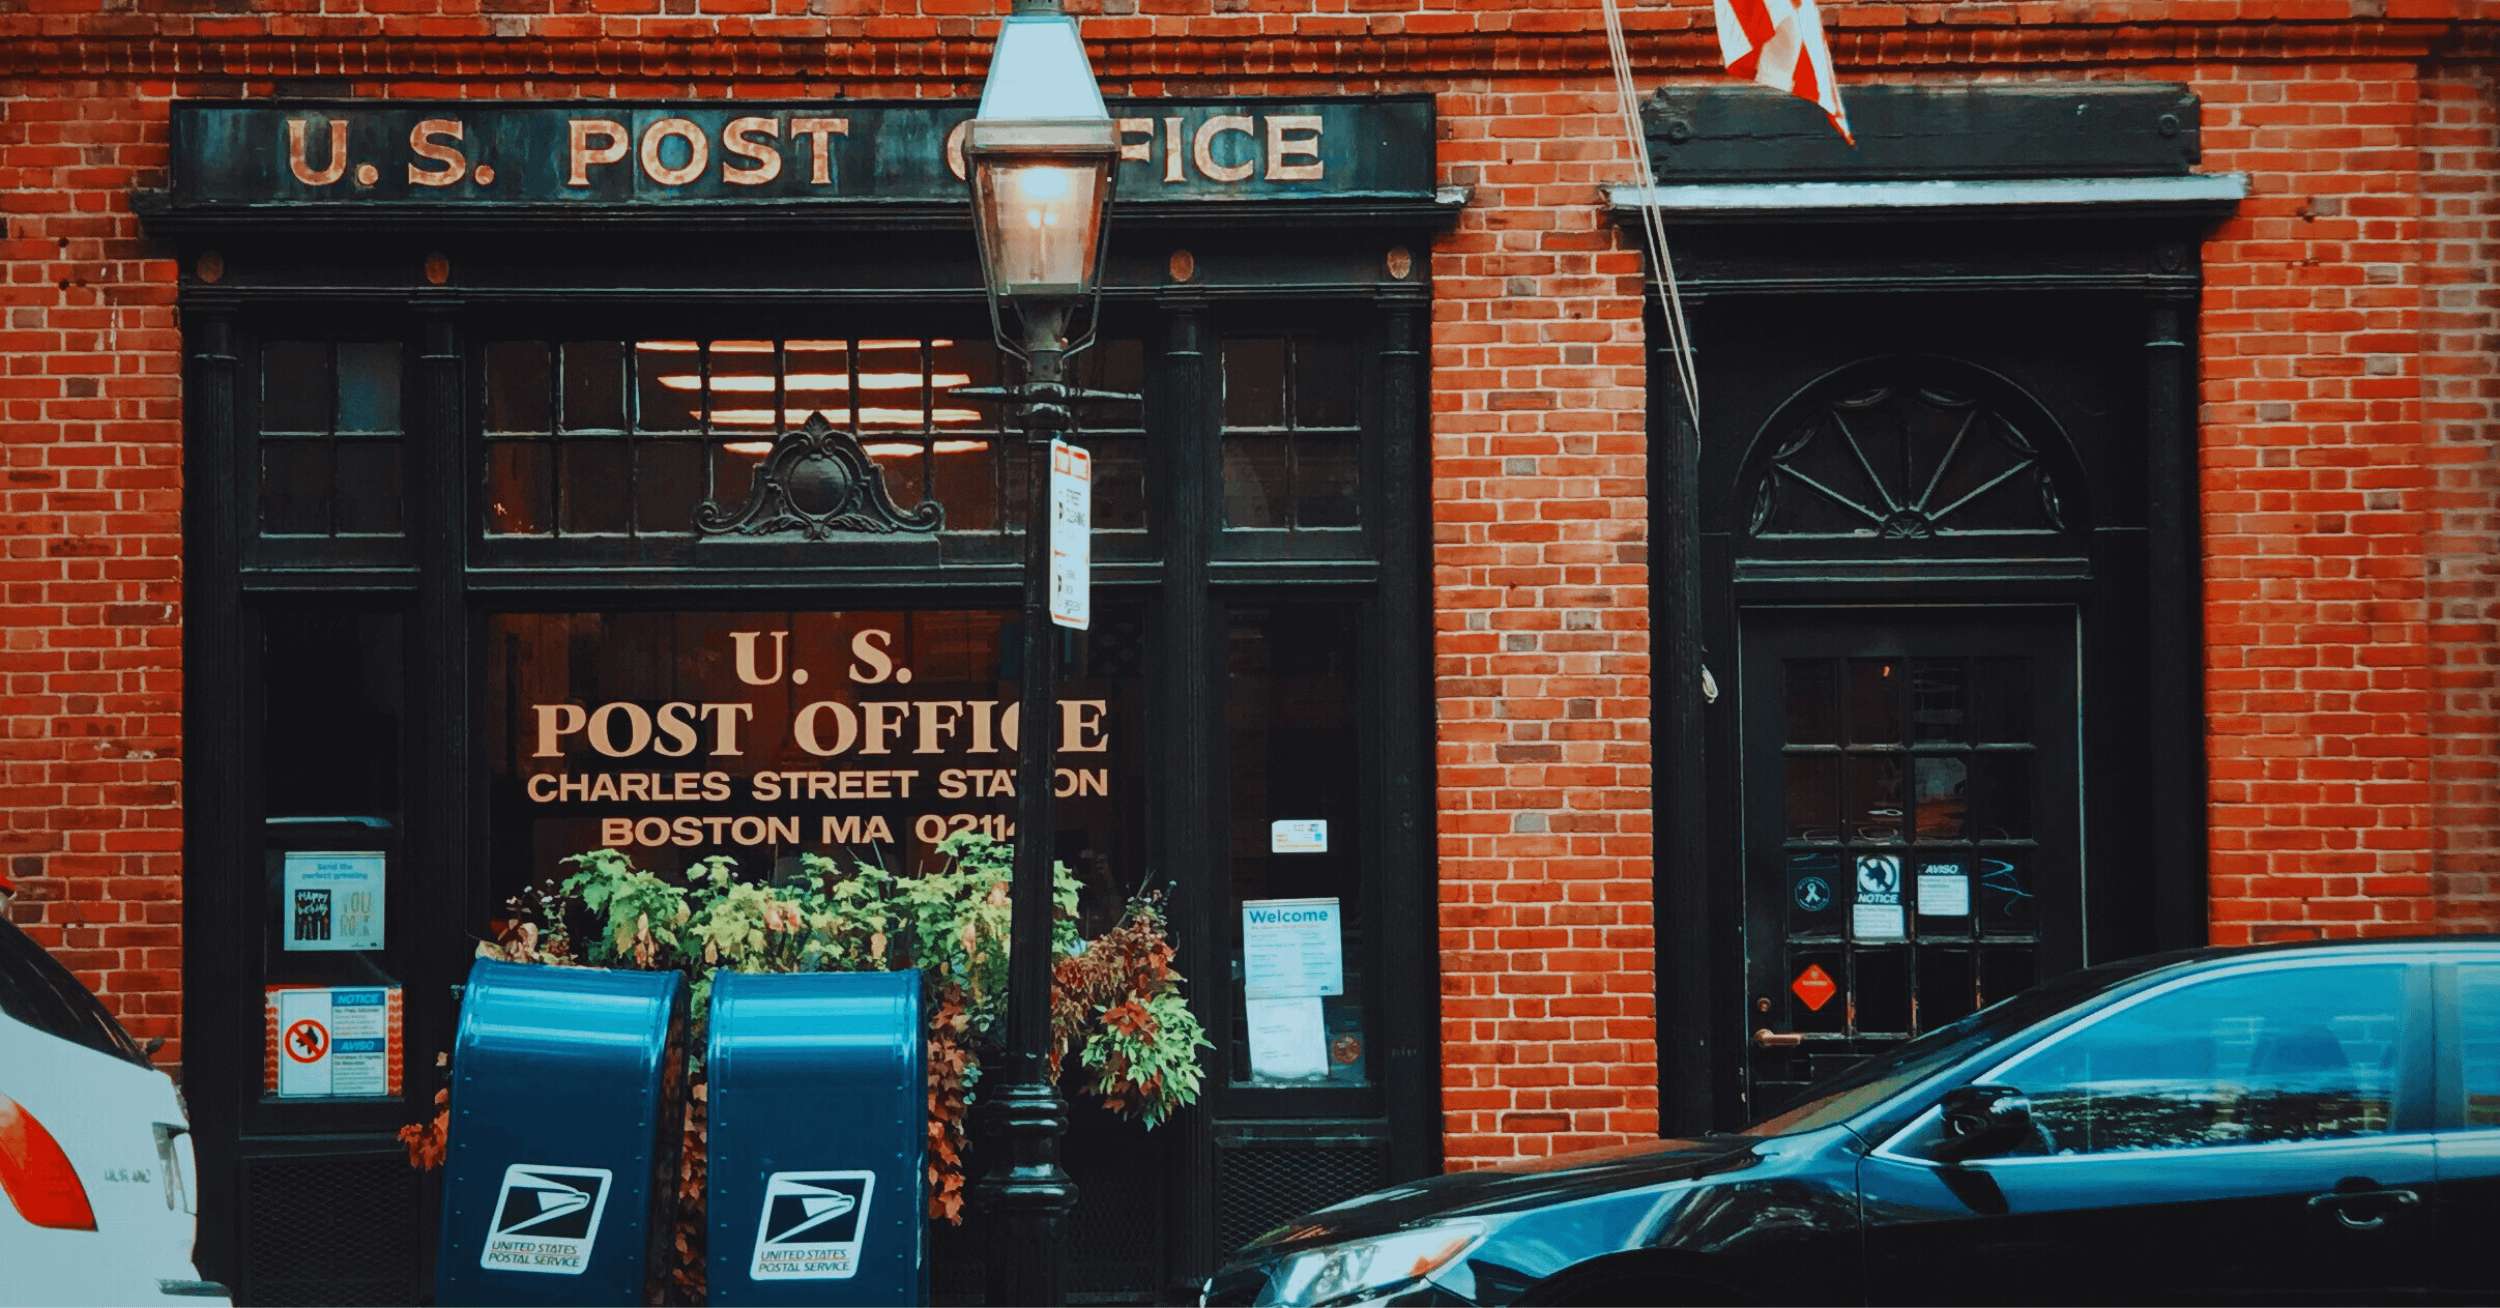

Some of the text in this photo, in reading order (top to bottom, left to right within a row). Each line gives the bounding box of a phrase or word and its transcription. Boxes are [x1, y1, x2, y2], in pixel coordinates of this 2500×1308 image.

[287, 116, 1324, 186] U. S. POST FICE
[729, 629, 912, 685] U. S.
[532, 702, 753, 757] POST
[527, 768, 1108, 803] CHARLES STREET STAON
[602, 813, 1016, 847] BOSTON MA 0211
[1925, 864, 1959, 874] AVISO
[1857, 893, 1899, 904] NOTICE
[1249, 909, 1329, 924] Welcome
[337, 993, 381, 1004] NOTICE
[341, 1040, 375, 1051] AVISO
[492, 1241, 577, 1255] UNITED STATES
[761, 1249, 847, 1261] UNITED STATES
[488, 1252, 581, 1267] POSTAL SERVICE
[758, 1261, 849, 1273] POSTAL SERVICE
